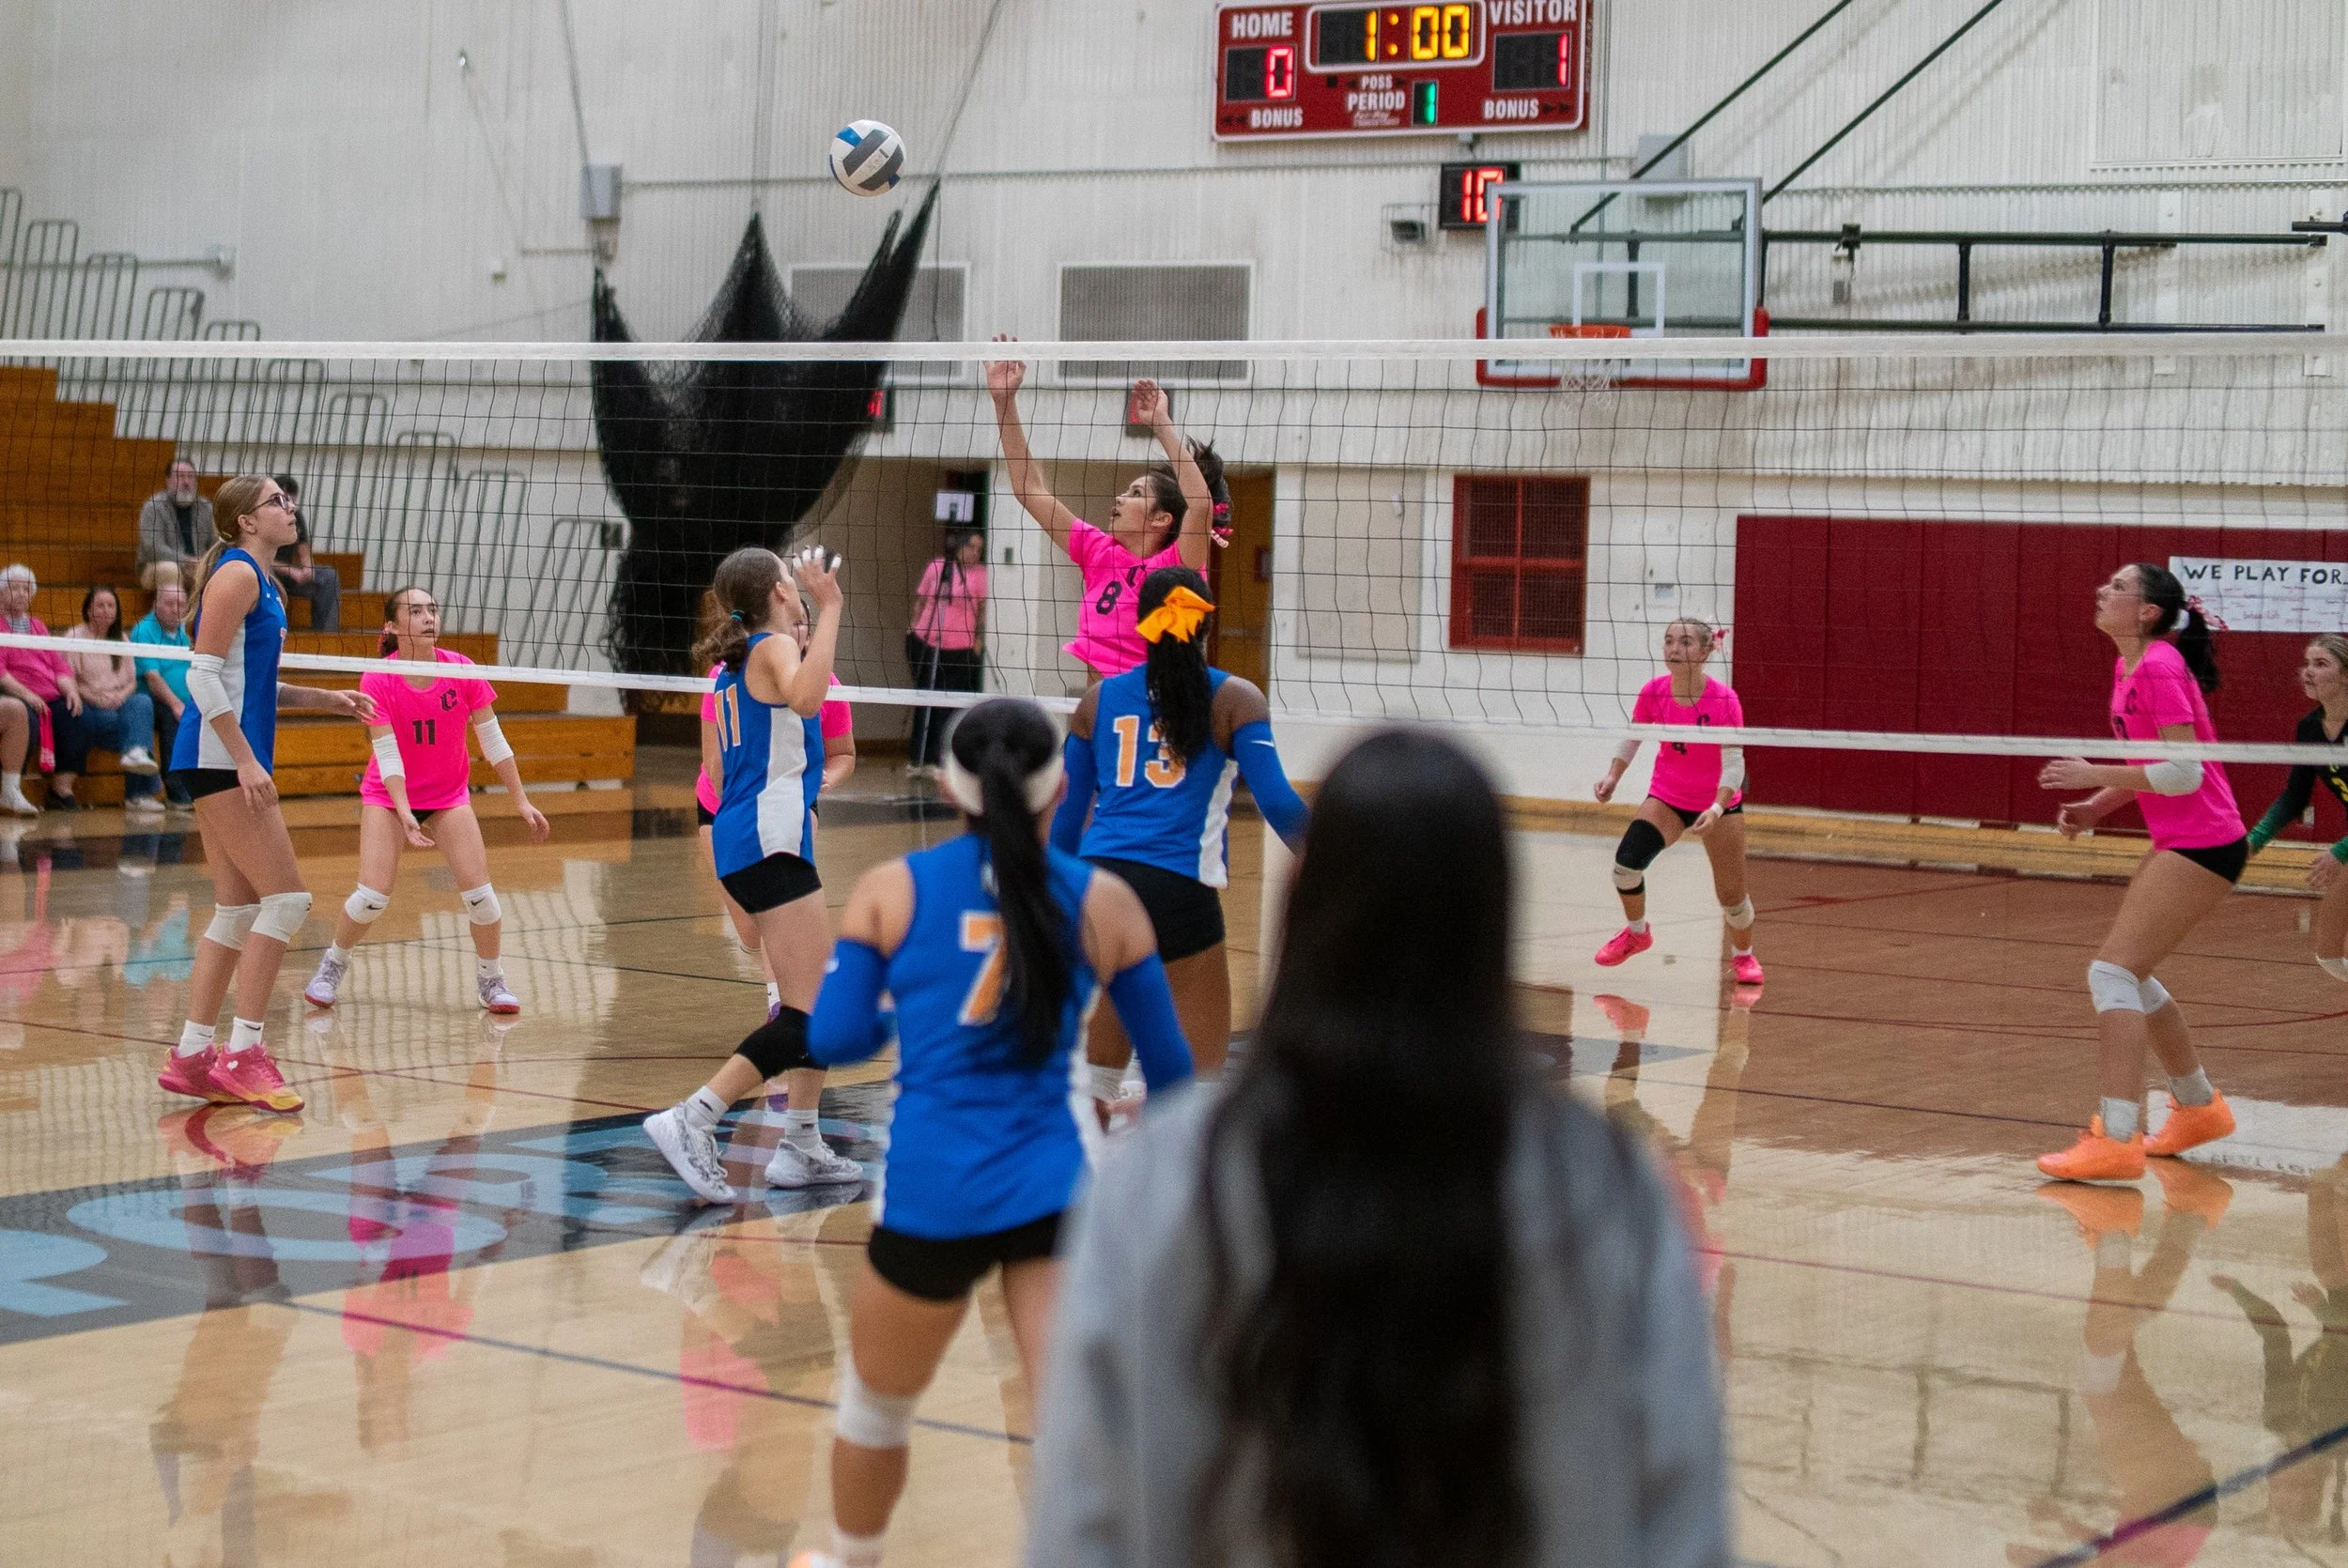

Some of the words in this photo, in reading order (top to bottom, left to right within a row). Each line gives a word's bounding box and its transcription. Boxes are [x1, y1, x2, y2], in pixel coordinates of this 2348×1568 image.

[1231, 11, 1293, 38] HOME
[1489, 0, 1577, 25] VISITOR
[1365, 5, 1470, 61] 1:00
[1265, 45, 1294, 99] 0
[1556, 33, 1568, 86] 1
[1361, 74, 1393, 90] POSS
[1347, 90, 1405, 112] PERIOD
[1424, 82, 1436, 124] 1
[1484, 98, 1539, 119] BONUS
[1250, 106, 1304, 129] BONUS
[2184, 564, 2222, 580] WE
[2234, 564, 2291, 582] PLAY
[1095, 580, 1122, 615] 8
[714, 683, 741, 752] 11
[411, 718, 436, 746] 11
[959, 910, 1012, 1025] 7
